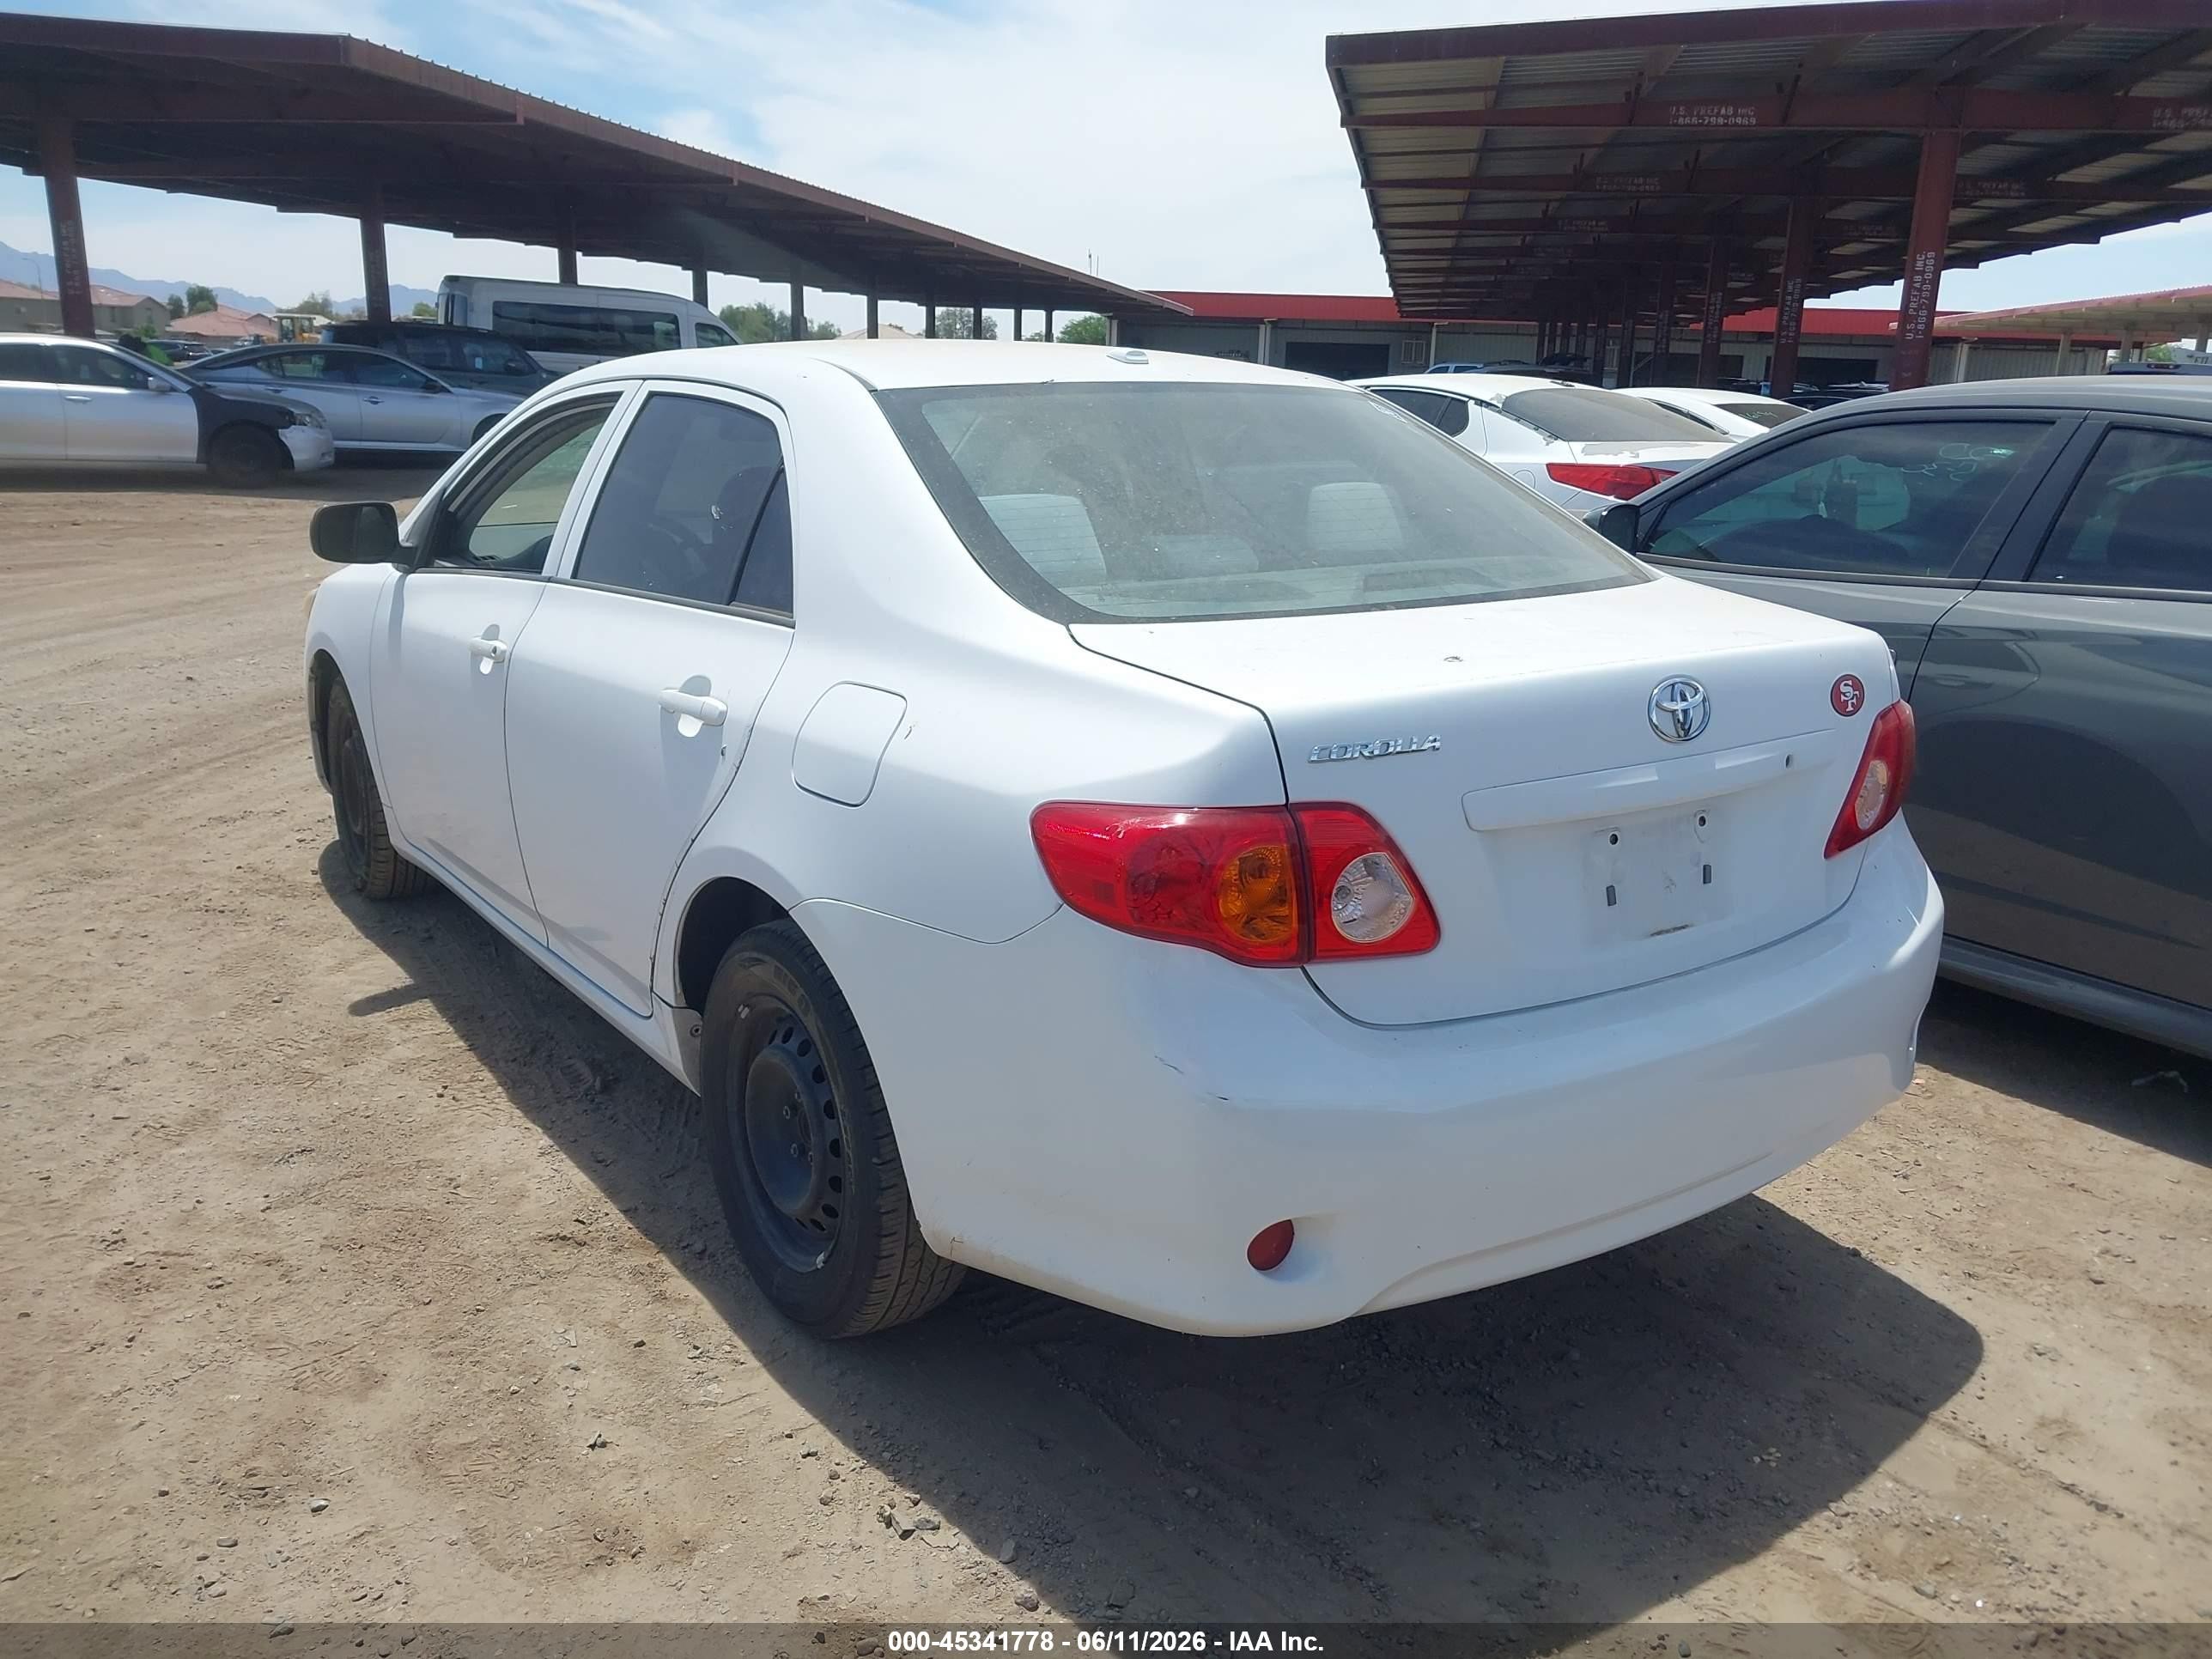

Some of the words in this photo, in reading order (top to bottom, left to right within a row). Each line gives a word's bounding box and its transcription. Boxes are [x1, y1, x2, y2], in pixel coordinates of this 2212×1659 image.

[1693, 106, 1733, 116] PREFAB
[1908, 275, 1923, 315] PREFAB
[1308, 733, 1443, 764] COROLLA
